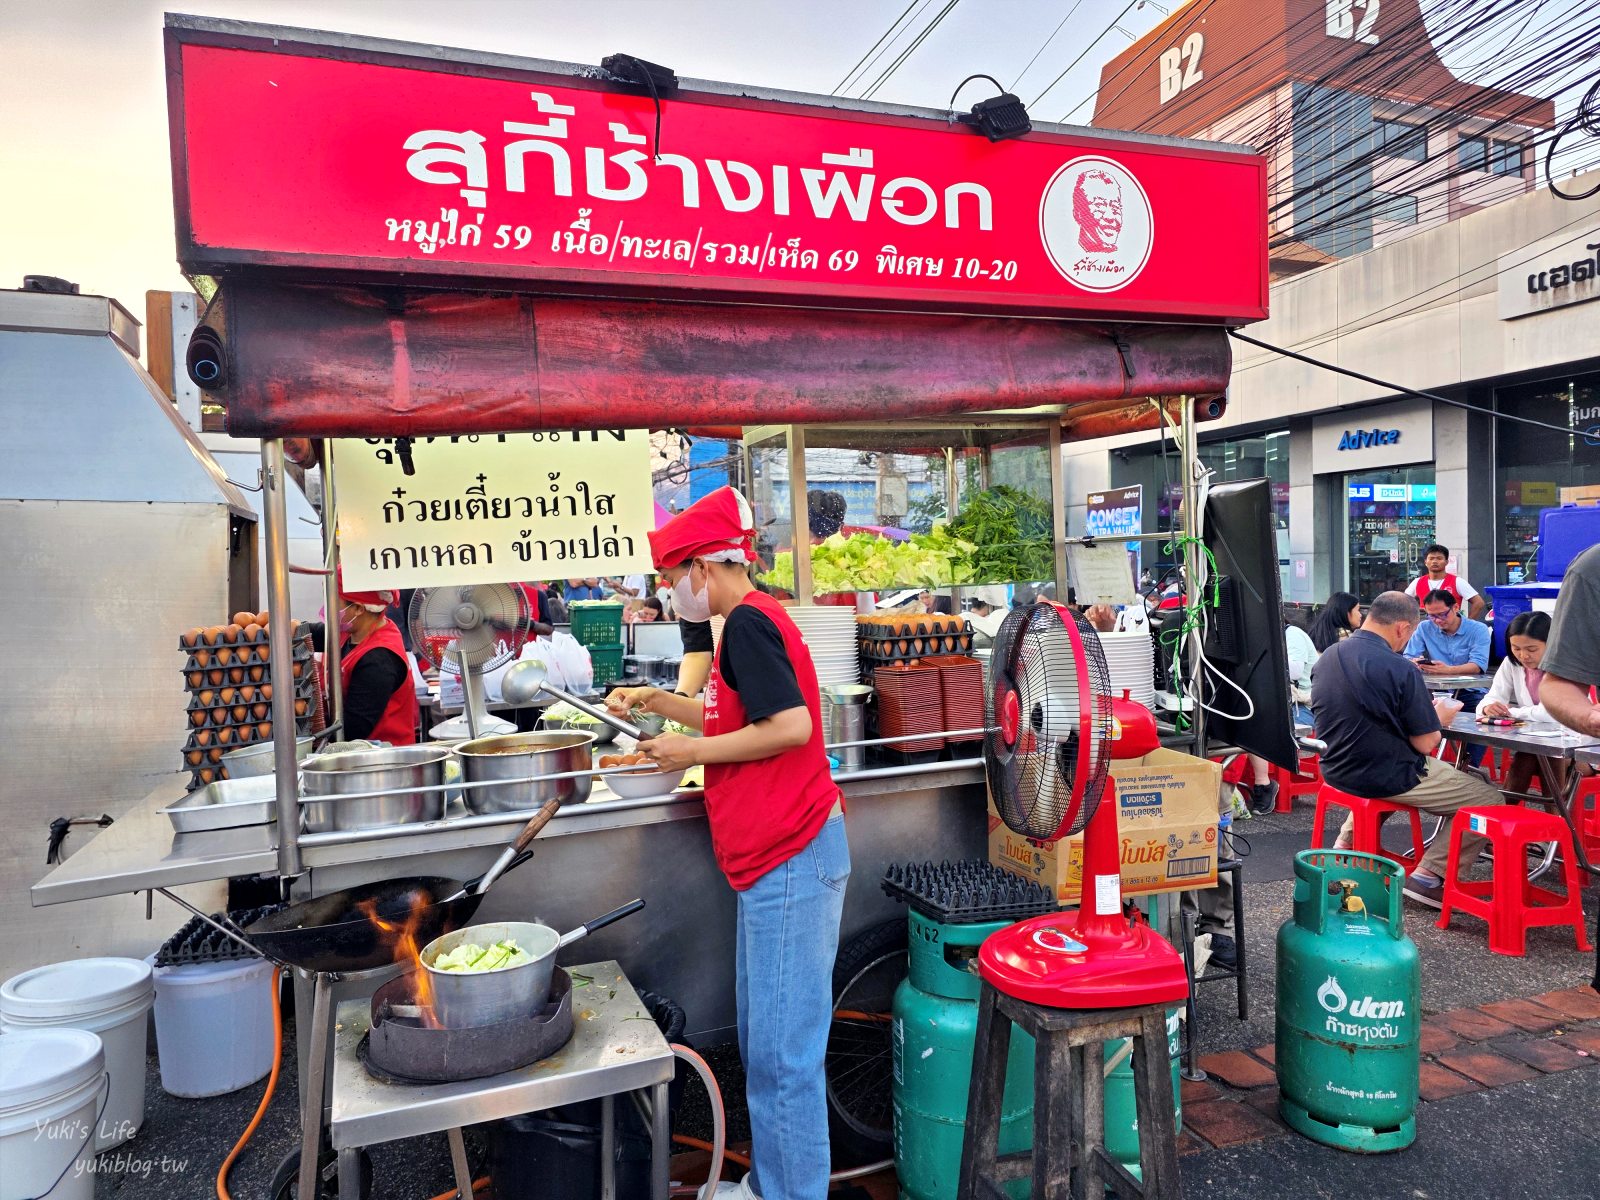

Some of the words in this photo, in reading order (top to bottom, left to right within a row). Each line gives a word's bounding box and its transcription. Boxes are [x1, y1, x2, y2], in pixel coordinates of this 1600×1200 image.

[1159, 32, 1203, 105] B2
[402, 91, 993, 231] สุกี้ช้างเผือก
[493, 224, 533, 250] 59
[828, 249, 859, 272] 69
[876, 244, 944, 277] พิเศษ
[951, 257, 1018, 281] 10-20
[1338, 428, 1401, 451] Advice
[382, 472, 616, 523] ก๋วยเตี๋ยวน้ำใส
[1089, 506, 1138, 528] COMSET
[369, 541, 494, 571] เกาเหลา
[511, 524, 635, 562] ข้าวเปล่า
[1005, 836, 1033, 865] โบนัส
[1120, 838, 1168, 865] โบนัส
[1349, 996, 1405, 1019] ปตท.
[1325, 1015, 1398, 1042] ก๊าซหุงต้ม
